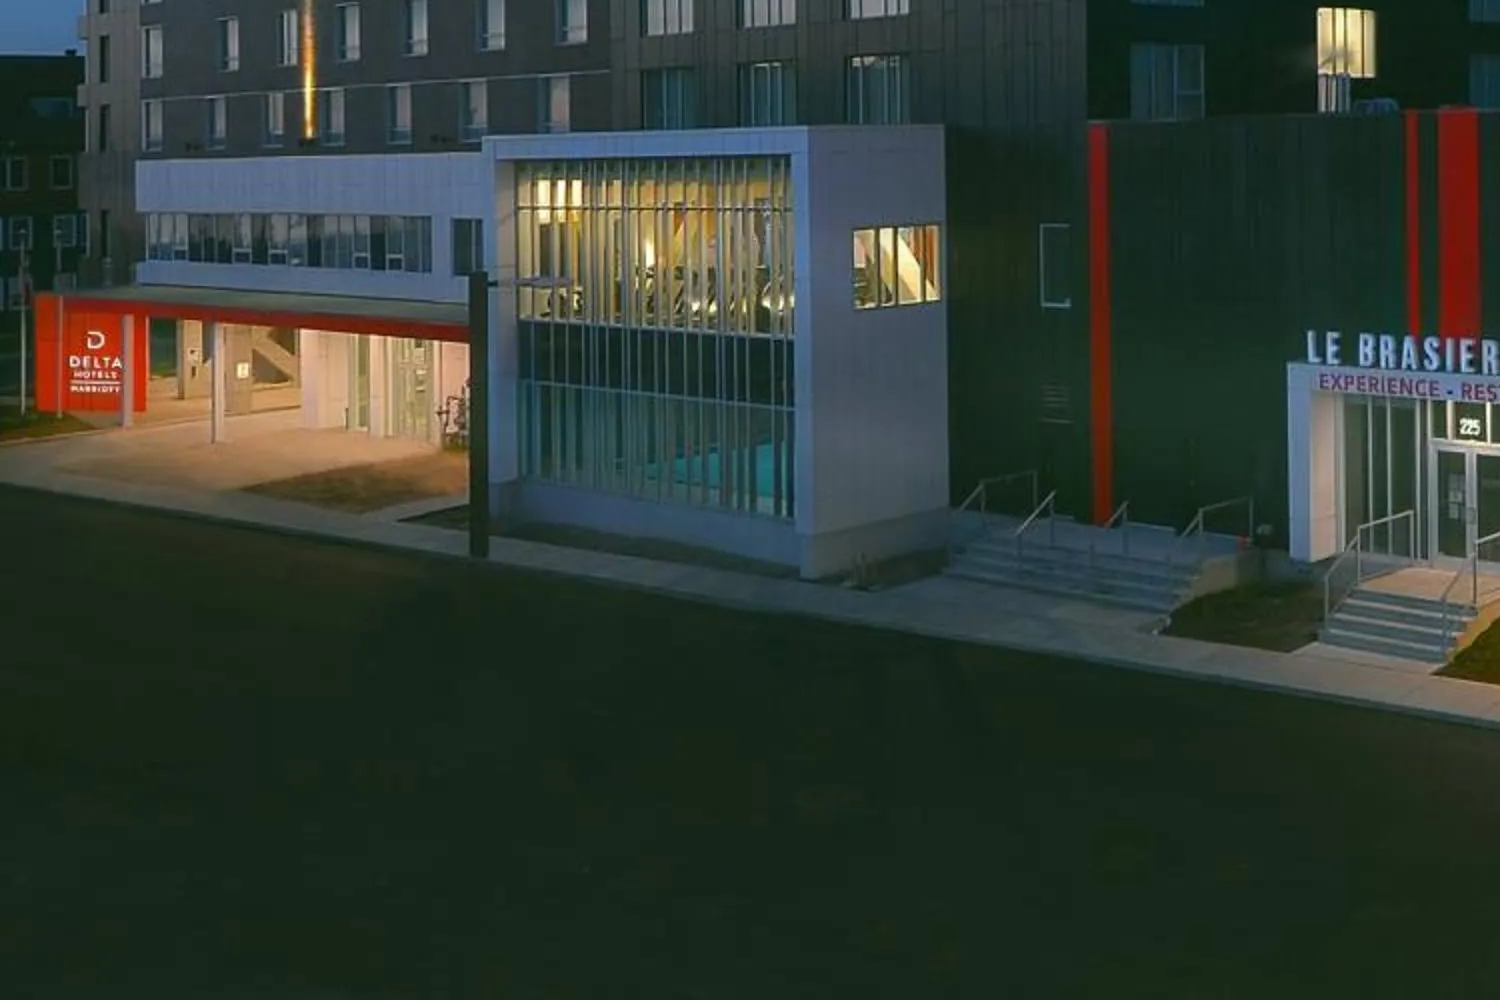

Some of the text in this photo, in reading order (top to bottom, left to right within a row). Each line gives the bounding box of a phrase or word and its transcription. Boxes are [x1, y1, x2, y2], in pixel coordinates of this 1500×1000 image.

[1306, 330, 1341, 365] LE
[1359, 333, 1500, 375] BRASIER
[69, 355, 123, 369] DELTA
[73, 371, 119, 379] HOTELS
[70, 385, 121, 393] MARRIOTT
[1319, 372, 1440, 398] EXPERIENCE
[1459, 418, 1481, 436] 225
